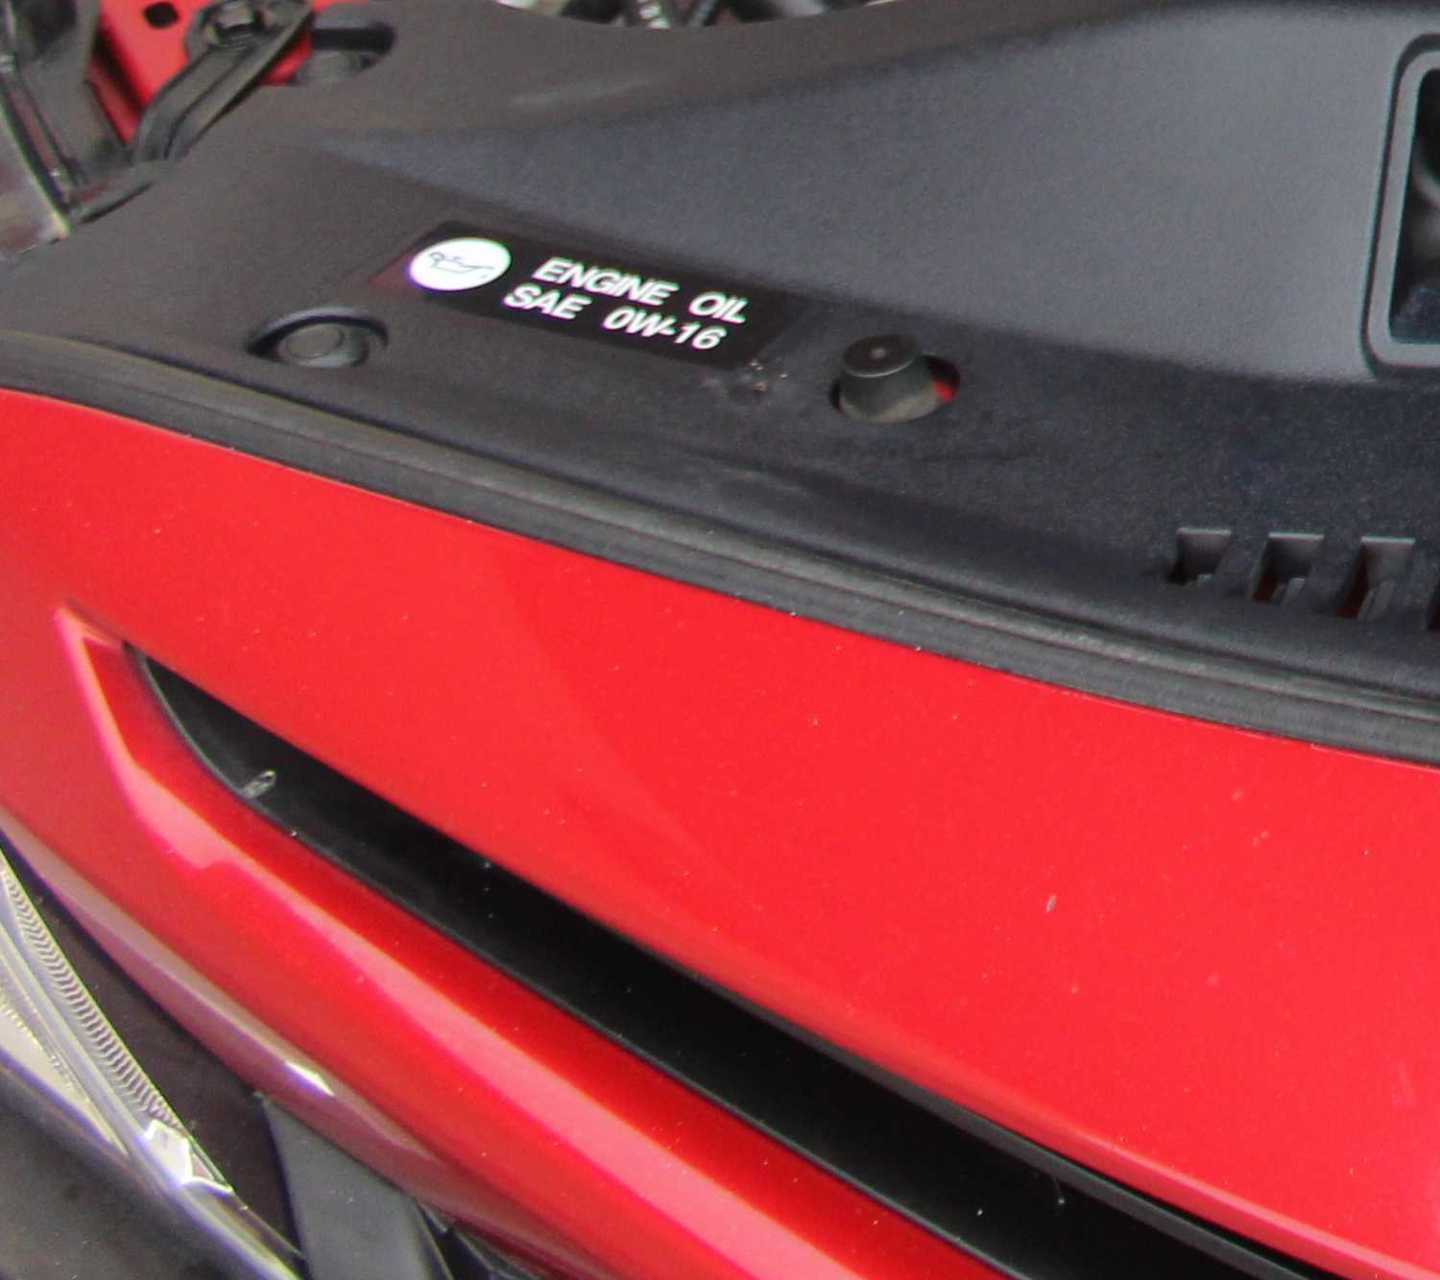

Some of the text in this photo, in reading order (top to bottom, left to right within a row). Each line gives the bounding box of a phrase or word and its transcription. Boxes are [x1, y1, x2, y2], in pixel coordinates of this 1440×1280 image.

[503, 282, 728, 351] SAE 0W-16
[531, 256, 748, 324] ENGINE OIL
